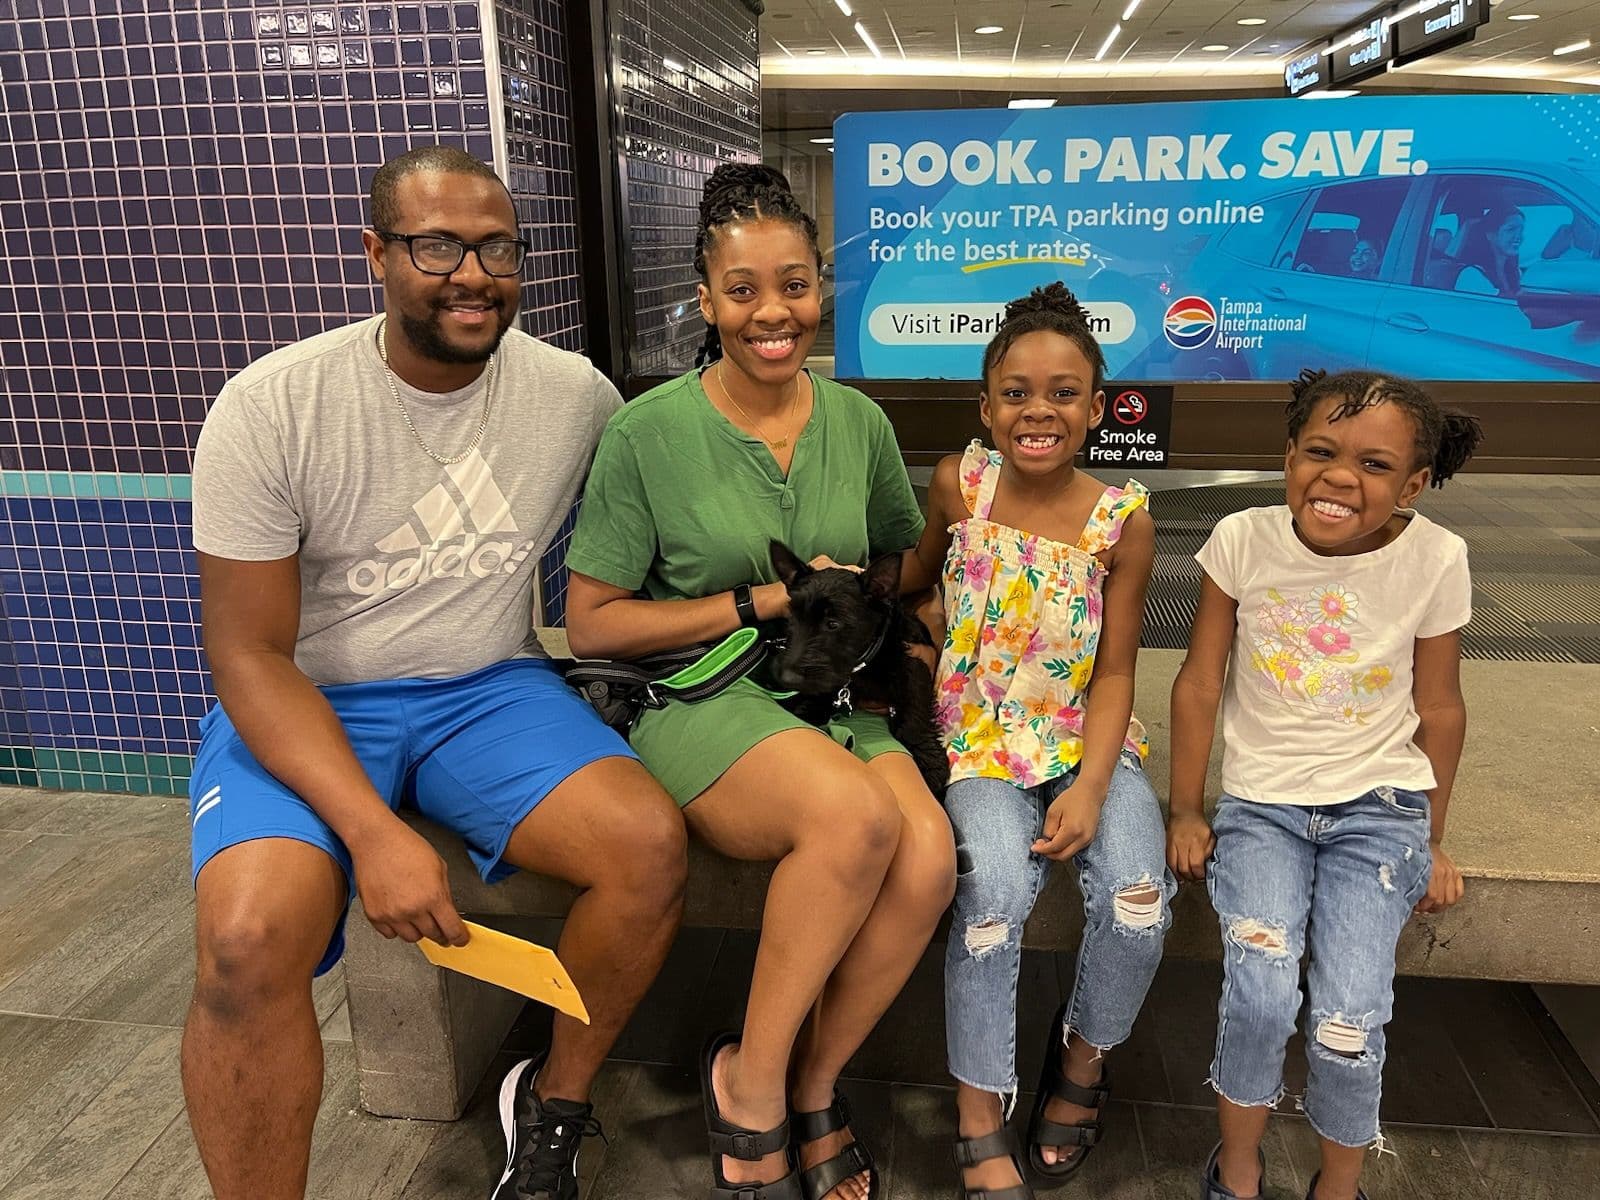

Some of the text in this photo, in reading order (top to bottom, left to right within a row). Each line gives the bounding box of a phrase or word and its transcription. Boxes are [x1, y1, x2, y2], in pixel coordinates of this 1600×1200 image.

[868, 129, 1429, 187] BOOK. PARK. SAVE.
[870, 200, 1264, 235] Book your TPA parking online
[869, 238, 1098, 262] for the best rates.
[1220, 297, 1263, 319] Tampa
[891, 314, 942, 334] Visit
[1219, 314, 1307, 331] International
[1215, 332, 1264, 354] Airport
[1100, 429, 1157, 444] Smoke
[1090, 447, 1164, 461] Free Area
[346, 532, 535, 596] adidas
